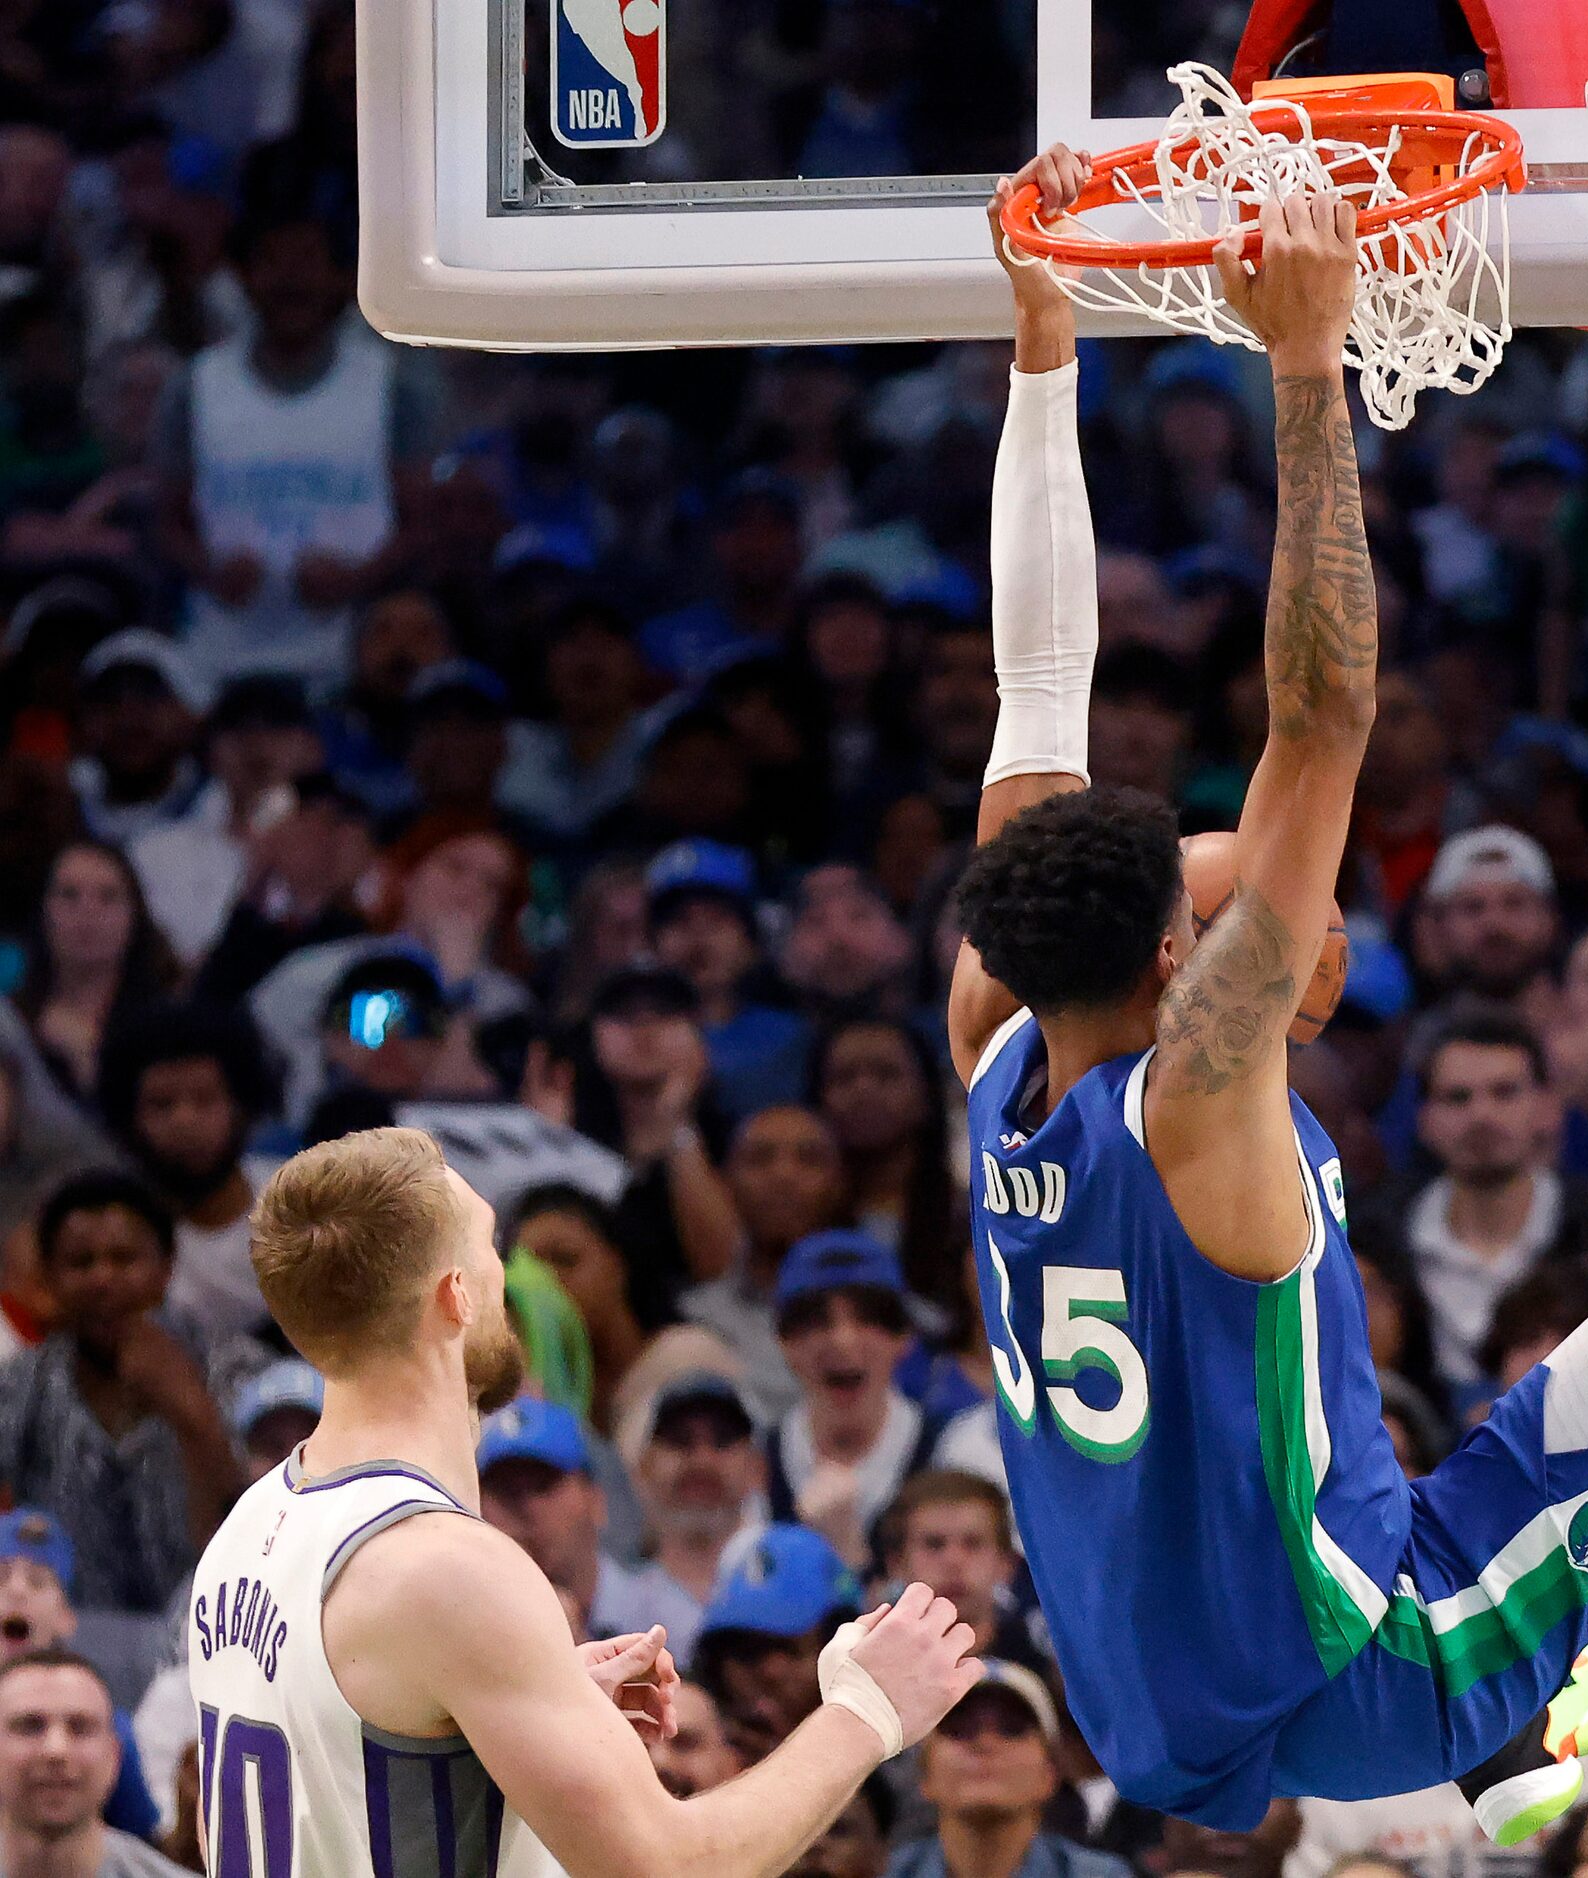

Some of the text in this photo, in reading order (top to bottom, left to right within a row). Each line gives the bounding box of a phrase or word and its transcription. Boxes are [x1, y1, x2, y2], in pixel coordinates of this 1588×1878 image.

[569, 89, 622, 130] NBA
[982, 1150, 1067, 1224] OOD
[195, 1577, 287, 1683] SABONIS
